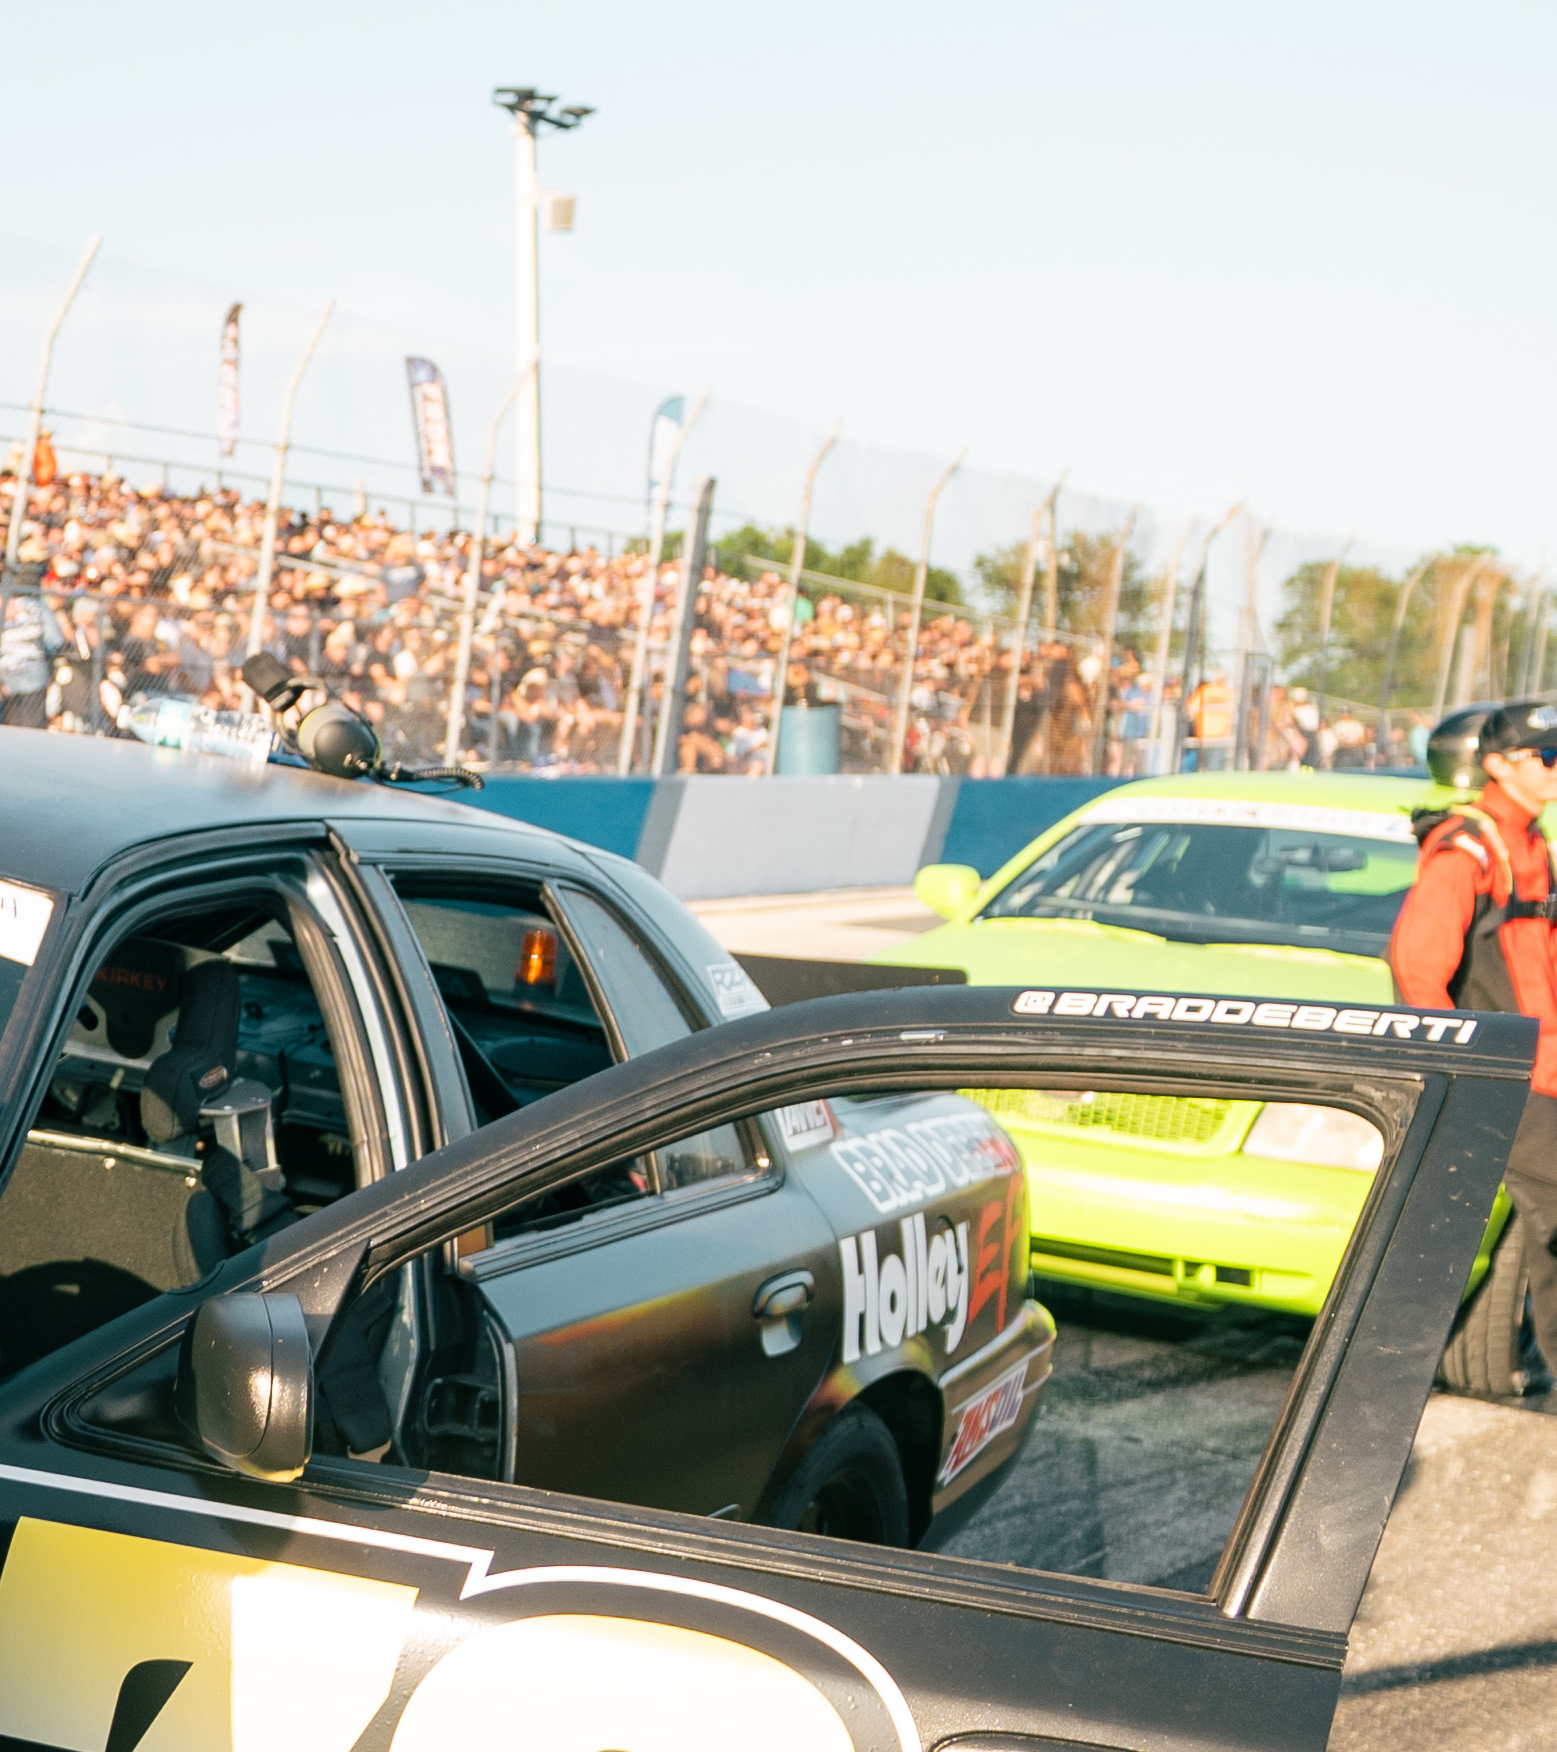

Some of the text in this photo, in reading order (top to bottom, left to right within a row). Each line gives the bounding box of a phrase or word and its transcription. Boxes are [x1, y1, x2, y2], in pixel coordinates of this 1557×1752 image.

[96, 966, 167, 991] KIRKEY
[1013, 989, 1477, 1045] @BRADDEBERTI
[840, 1212, 970, 1364] Holley
